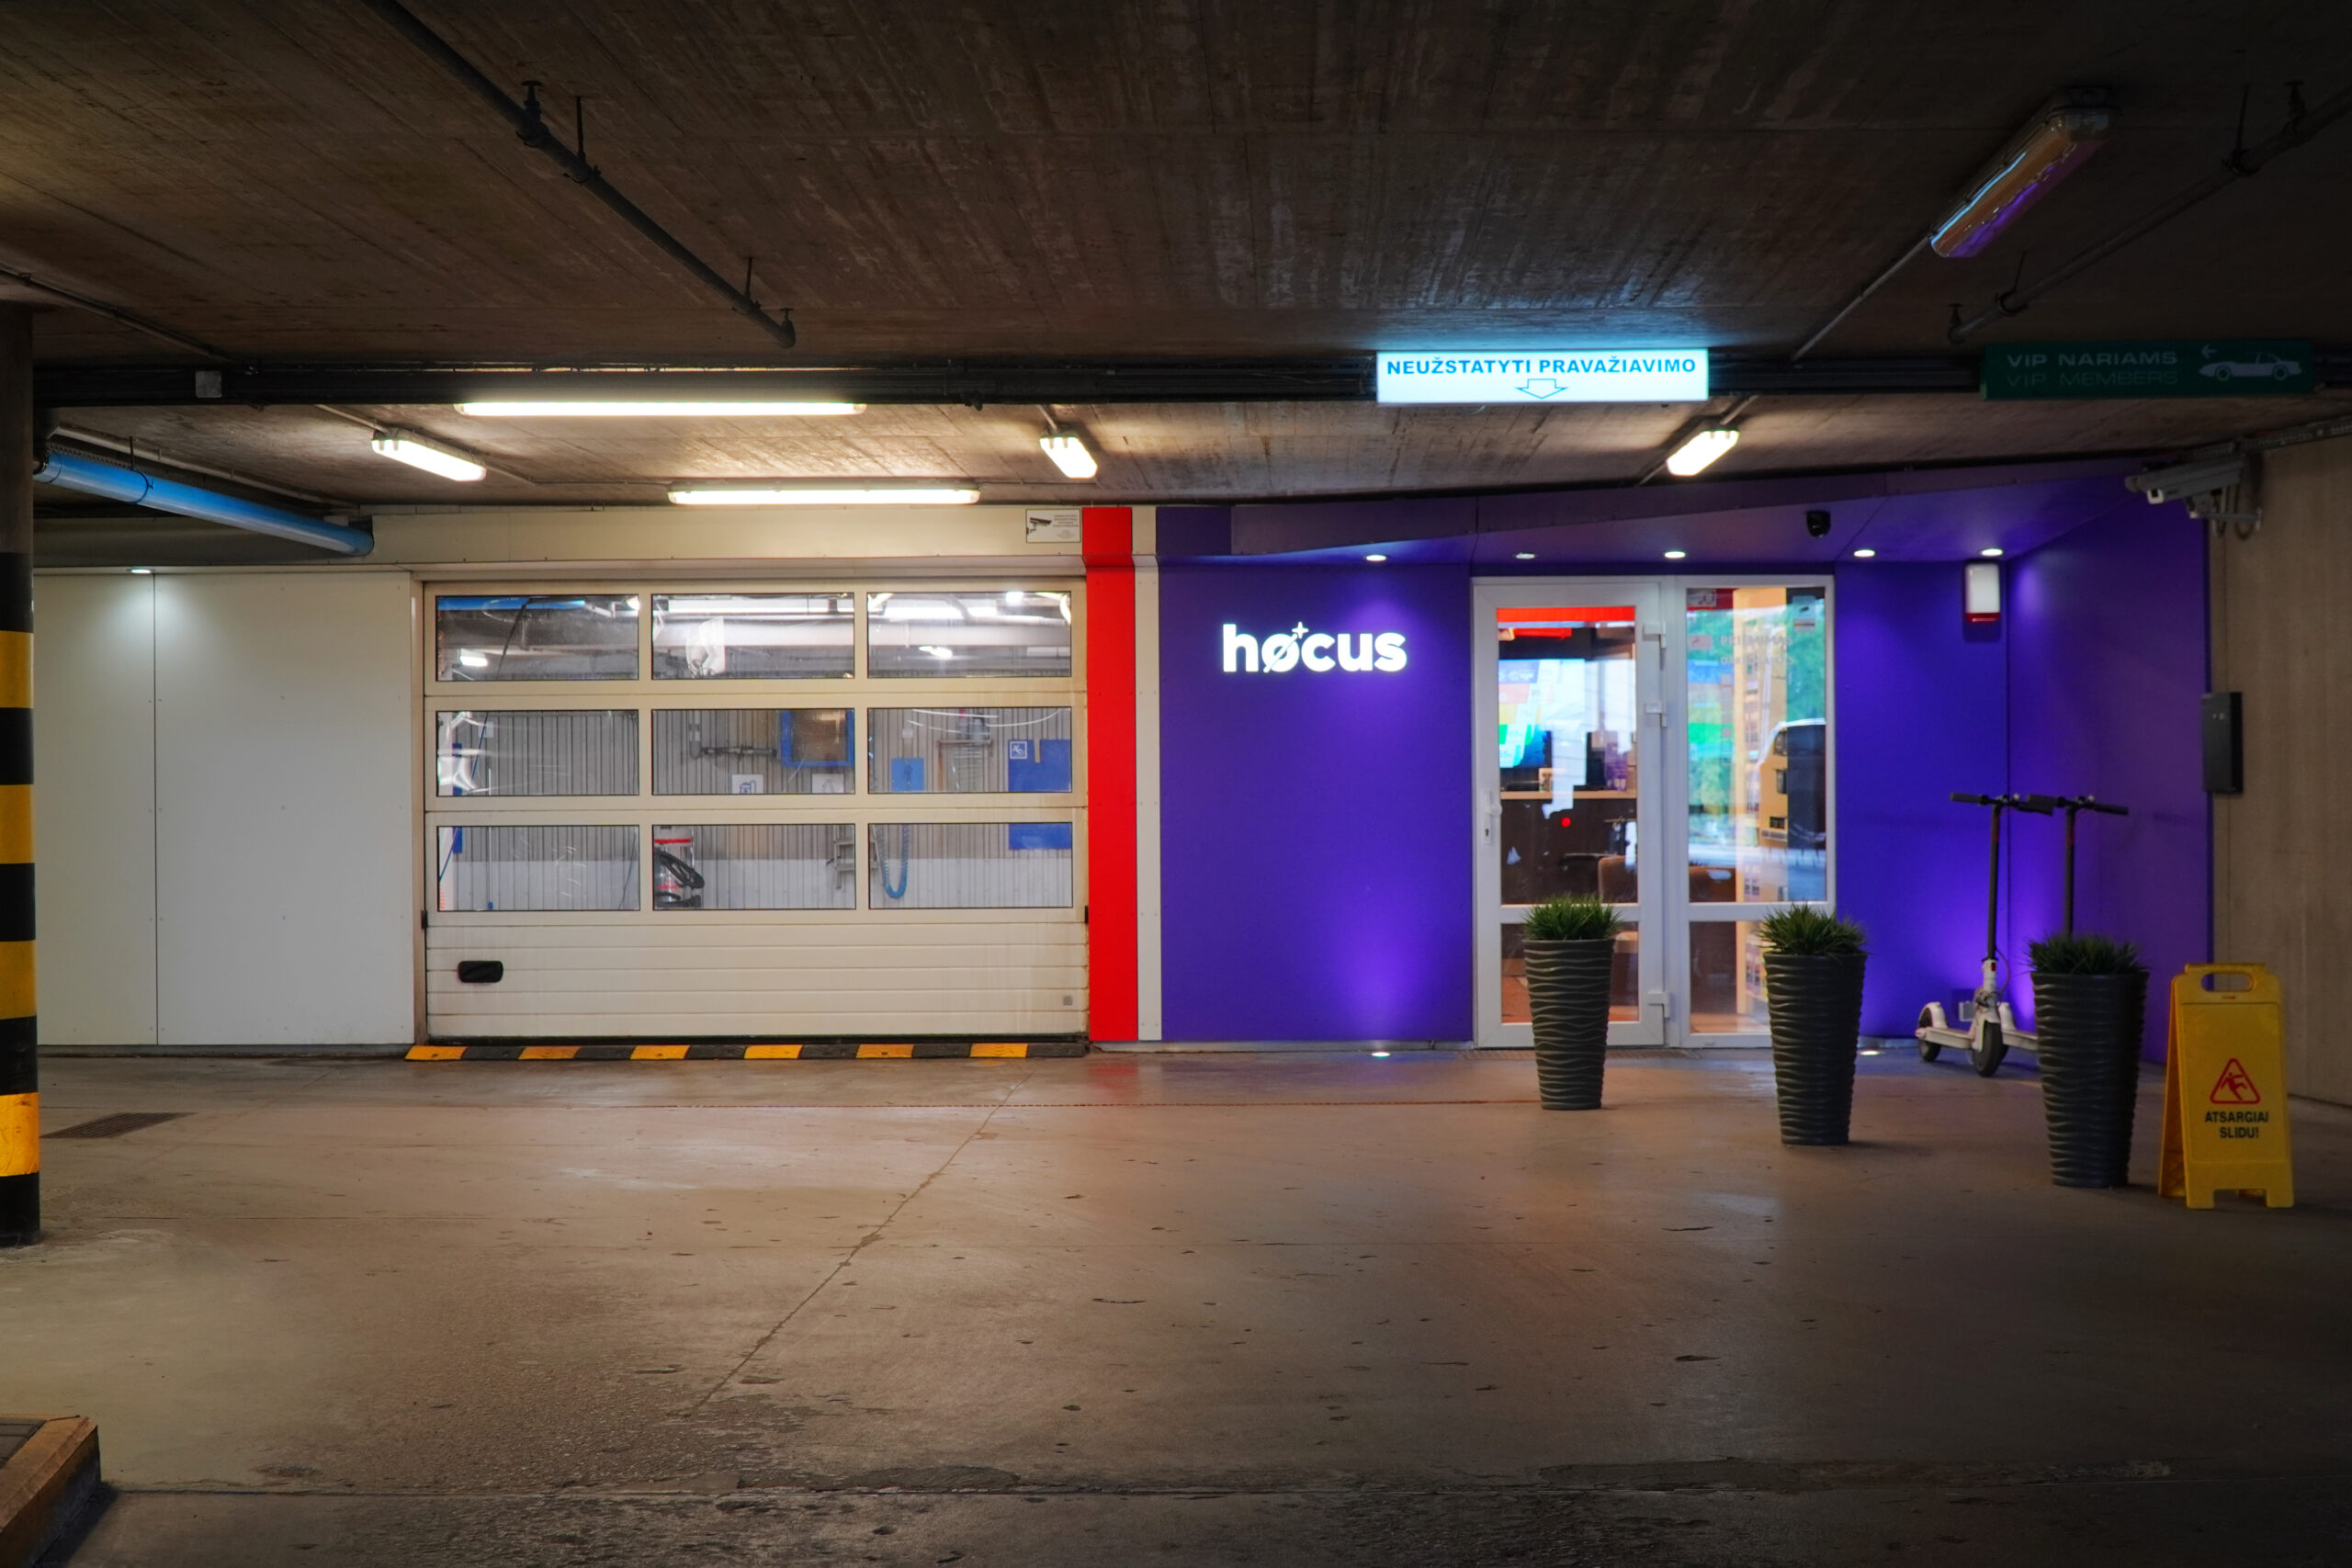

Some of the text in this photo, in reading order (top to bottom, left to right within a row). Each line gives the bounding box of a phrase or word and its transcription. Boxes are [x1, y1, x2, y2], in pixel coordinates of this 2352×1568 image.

[1386, 355, 1696, 375] NEUŽSTATYTI PRAVAŽIAVIMO
[2007, 352, 2178, 367] VIP NARIAMS
[2007, 370, 2178, 387] VIP MEMBERS
[2204, 1111, 2269, 1123] ATSARGIAI
[2219, 1126, 2259, 1139] SLIDU!
